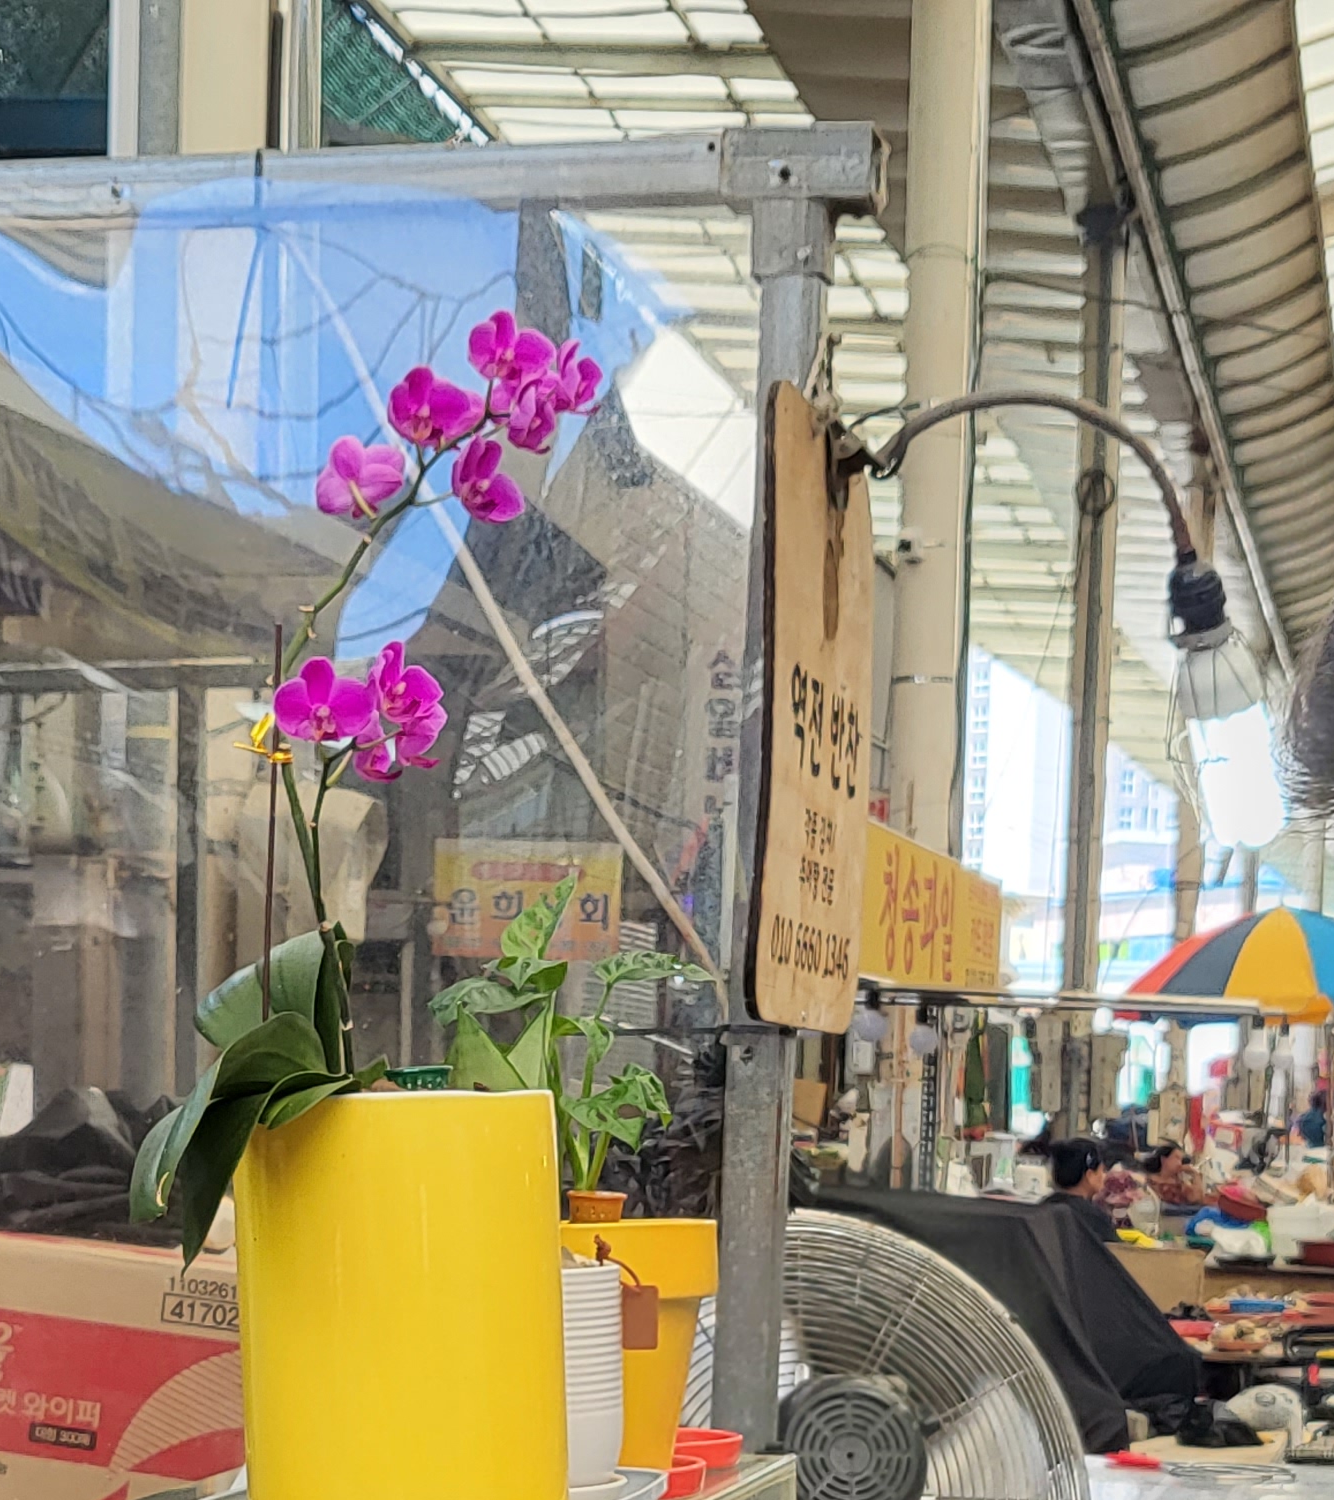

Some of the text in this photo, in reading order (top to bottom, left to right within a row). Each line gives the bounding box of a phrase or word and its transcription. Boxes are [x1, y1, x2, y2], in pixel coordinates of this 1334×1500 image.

[791, 663, 823, 777] 역전
[830, 692, 862, 799] 반찬
[449, 889, 610, 931] 윤희회
[879, 843, 956, 983] 청송과일
[770, 912, 794, 966] 010
[793, 921, 823, 975] 6660
[170, 1300, 239, 1326] 41702
[22, 1391, 102, 1428] 와이퍼
